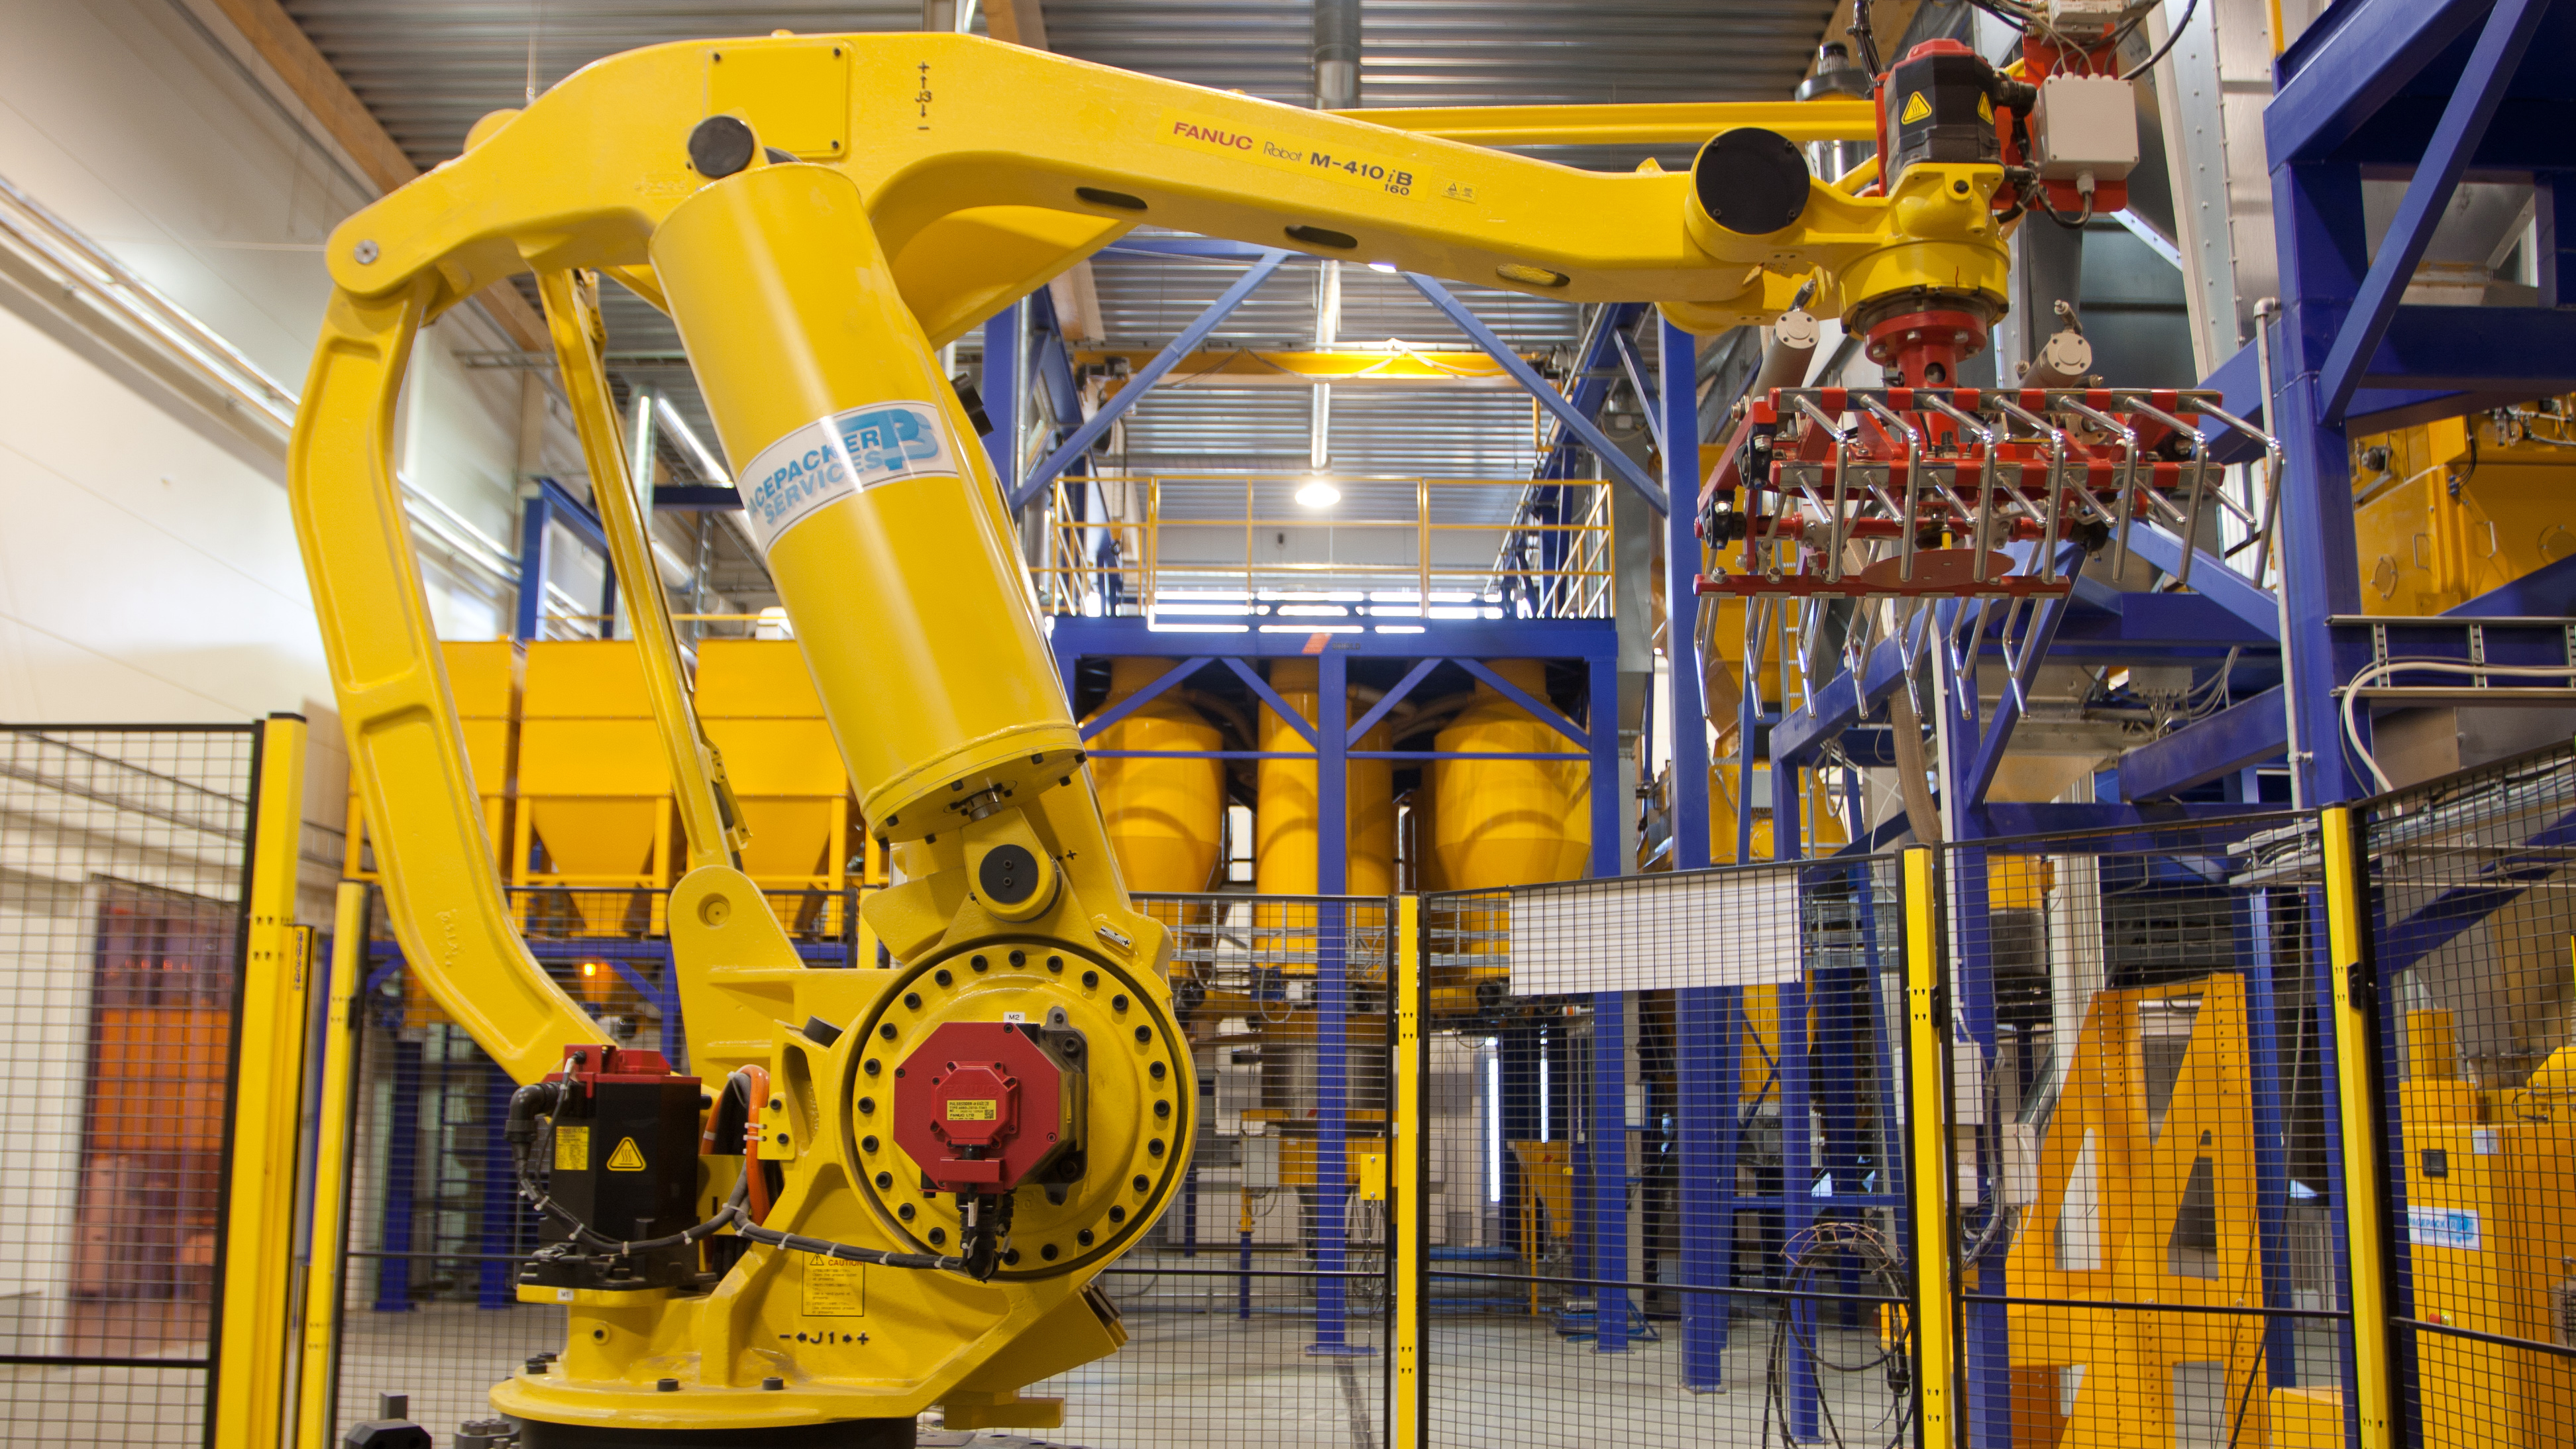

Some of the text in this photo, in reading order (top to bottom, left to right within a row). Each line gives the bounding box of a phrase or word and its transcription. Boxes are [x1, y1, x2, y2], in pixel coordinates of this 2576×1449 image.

[915, 91, 932, 103] J3
[1172, 121, 1254, 150] FANUC
[1263, 141, 1303, 162] Robot
[1384, 183, 1410, 197] 160
[764, 451, 885, 525] SERVICES
[809, 1330, 835, 1344] J1
